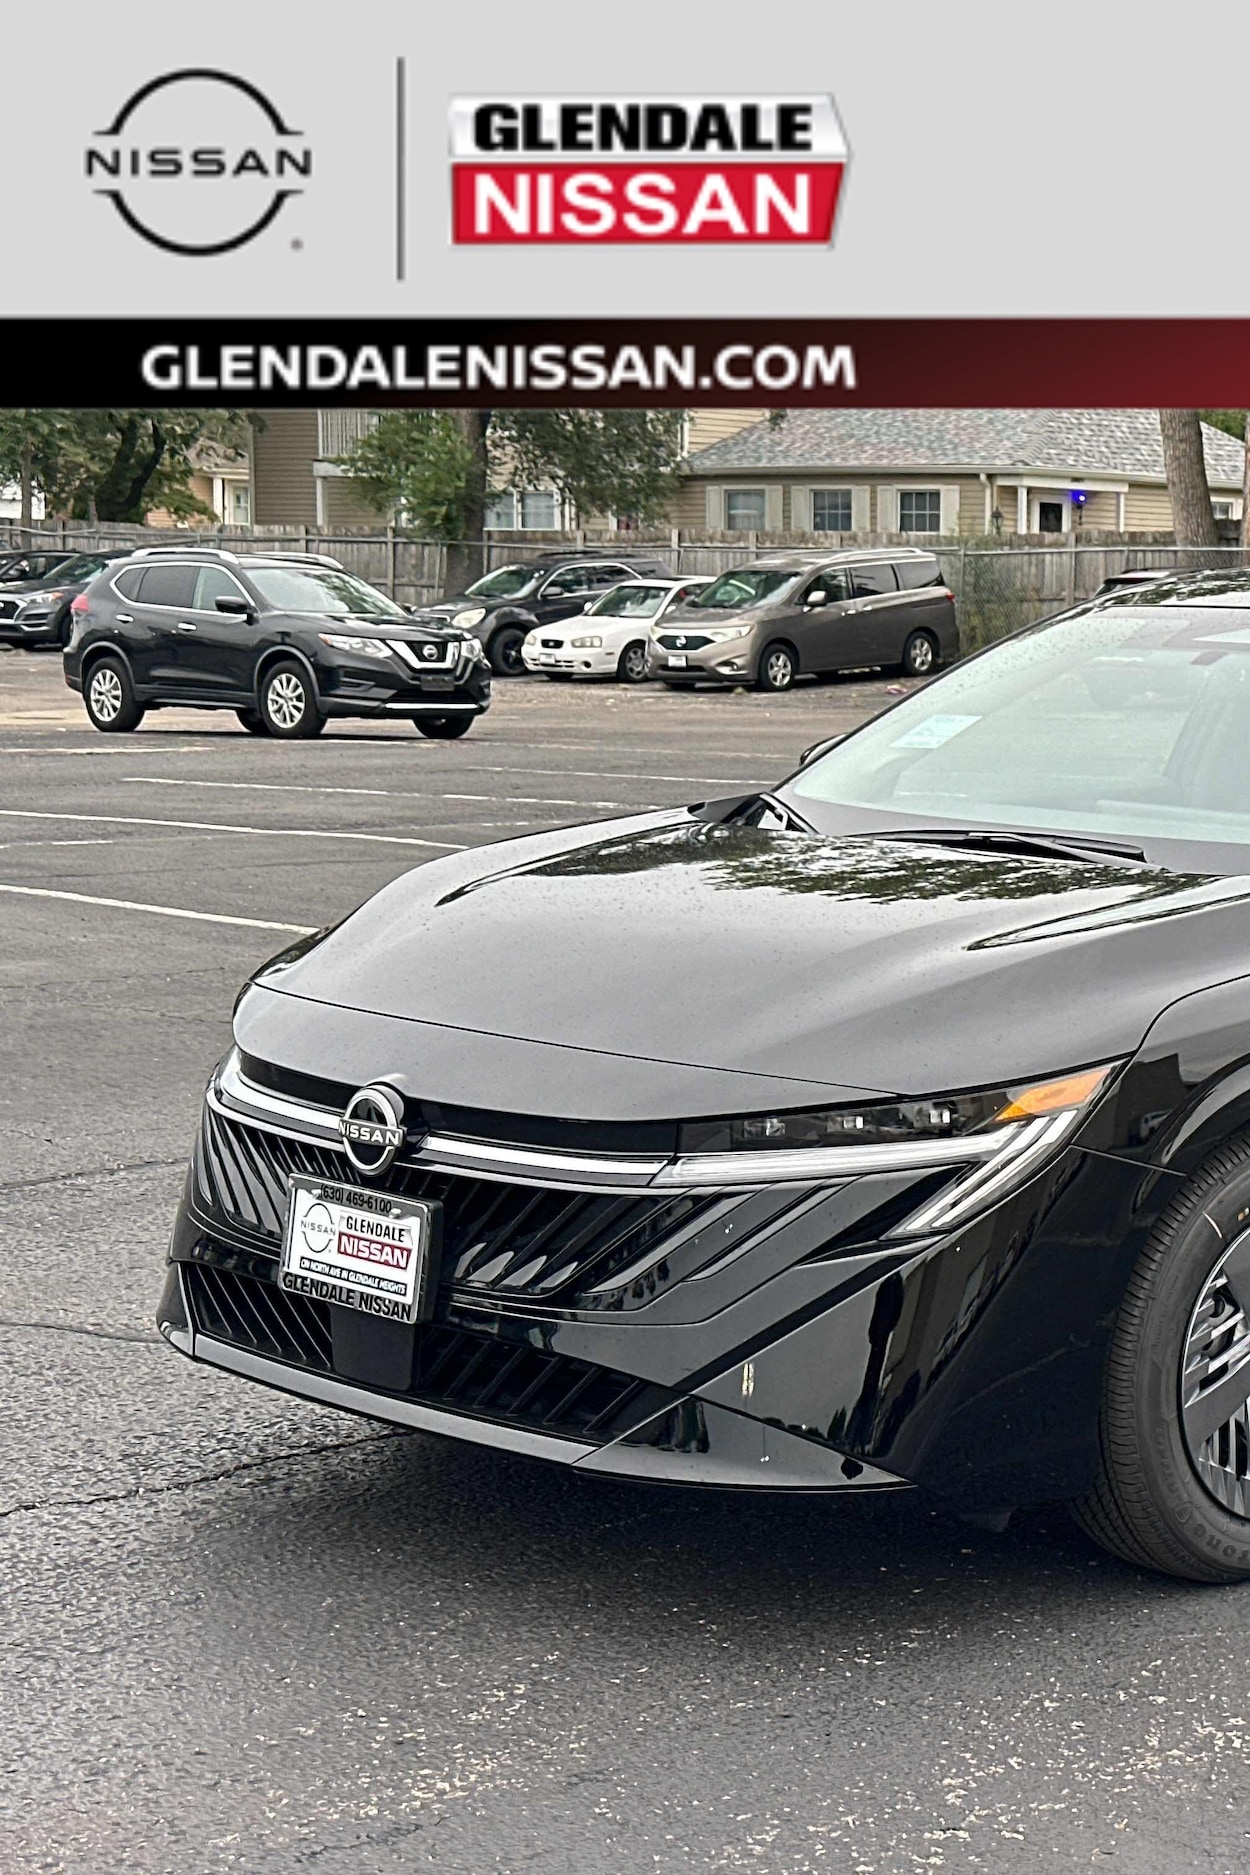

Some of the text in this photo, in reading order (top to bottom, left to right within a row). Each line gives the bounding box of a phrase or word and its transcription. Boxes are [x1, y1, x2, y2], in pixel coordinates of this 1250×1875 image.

[338, 1120, 400, 1147] NISSAN
[346, 1191, 392, 1214] 469-6100
[301, 1220, 337, 1237] NISSAN
[346, 1216, 406, 1243] GLENDALE
[341, 1235, 408, 1269] NISSAN
[283, 1272, 412, 1321] GLENDALE NISSAN
